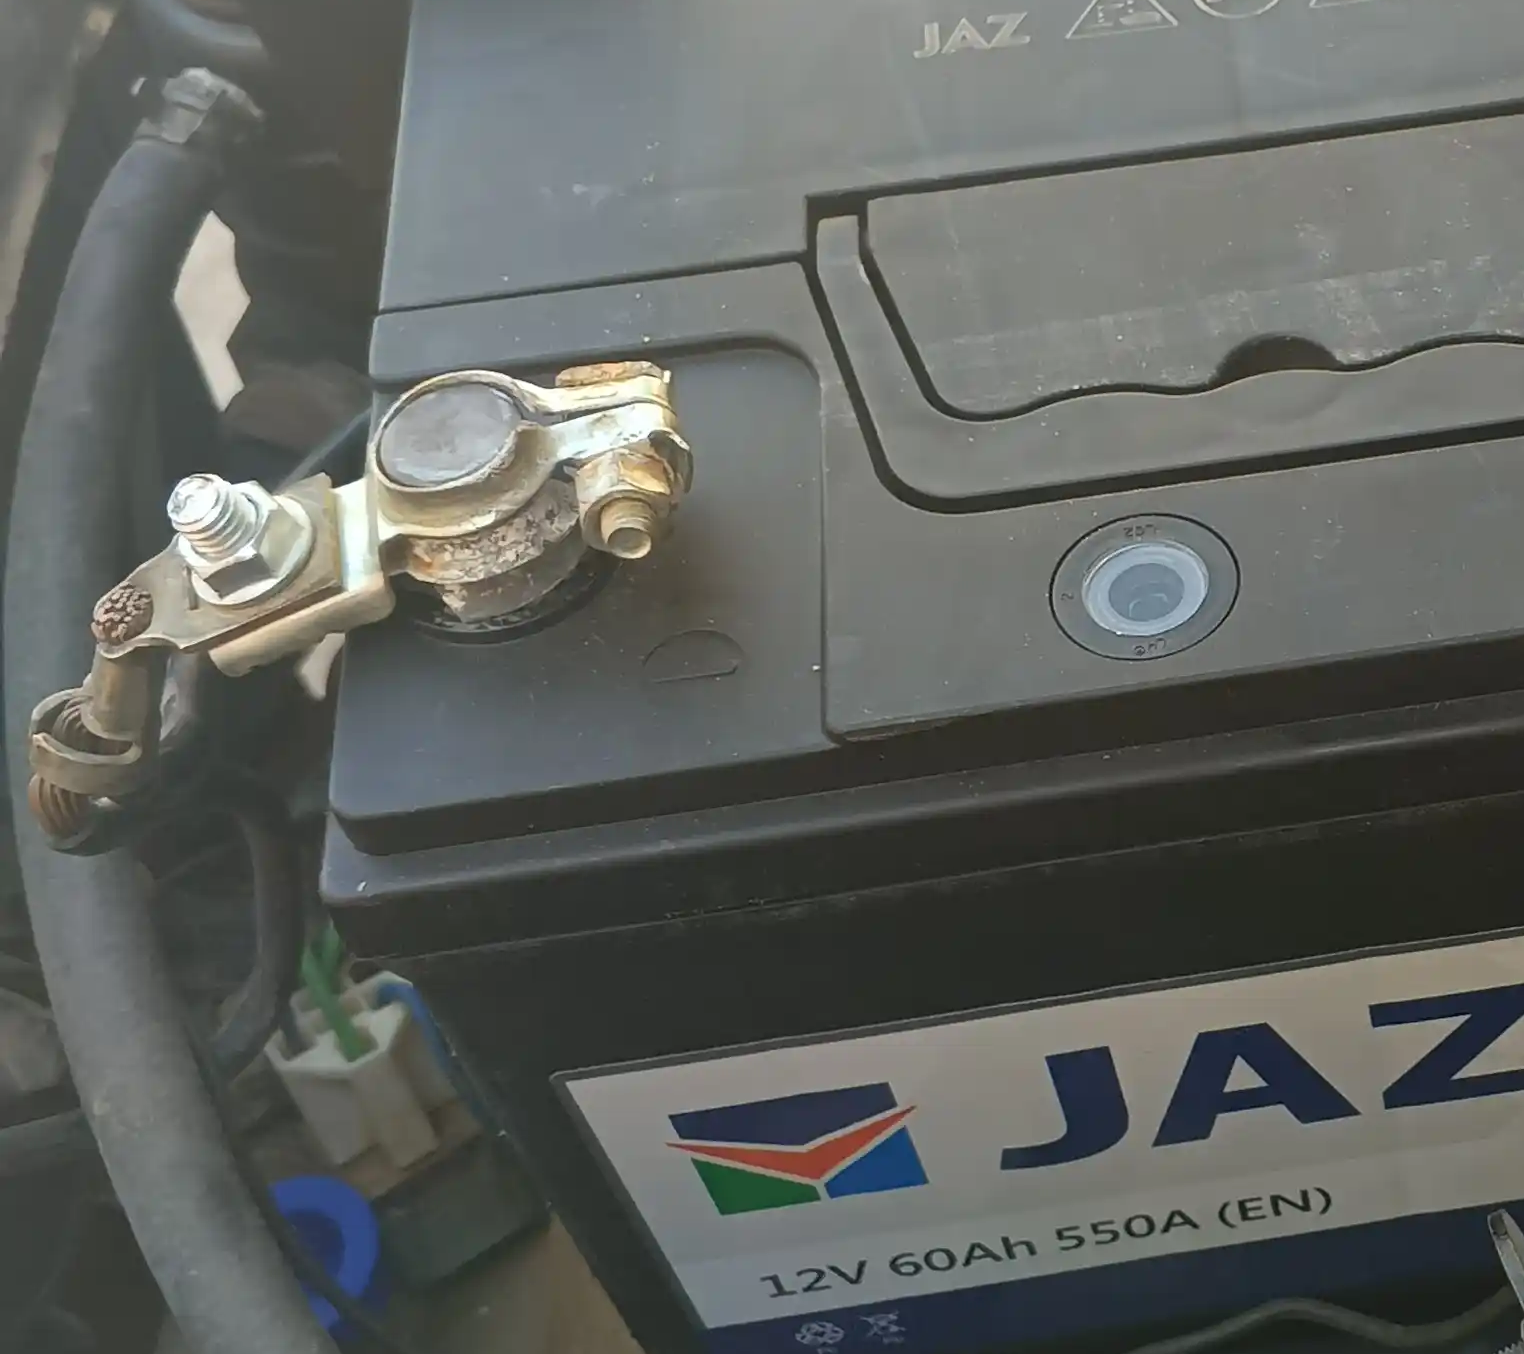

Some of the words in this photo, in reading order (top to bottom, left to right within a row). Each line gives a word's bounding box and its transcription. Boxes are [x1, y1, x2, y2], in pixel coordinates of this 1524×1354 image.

[913, 11, 1031, 59] JAZ
[759, 1259, 868, 1297] 12V
[889, 1234, 1036, 1276] 60Ah
[1055, 1209, 1199, 1251] 550A
[1217, 1187, 1333, 1229] (EN)
